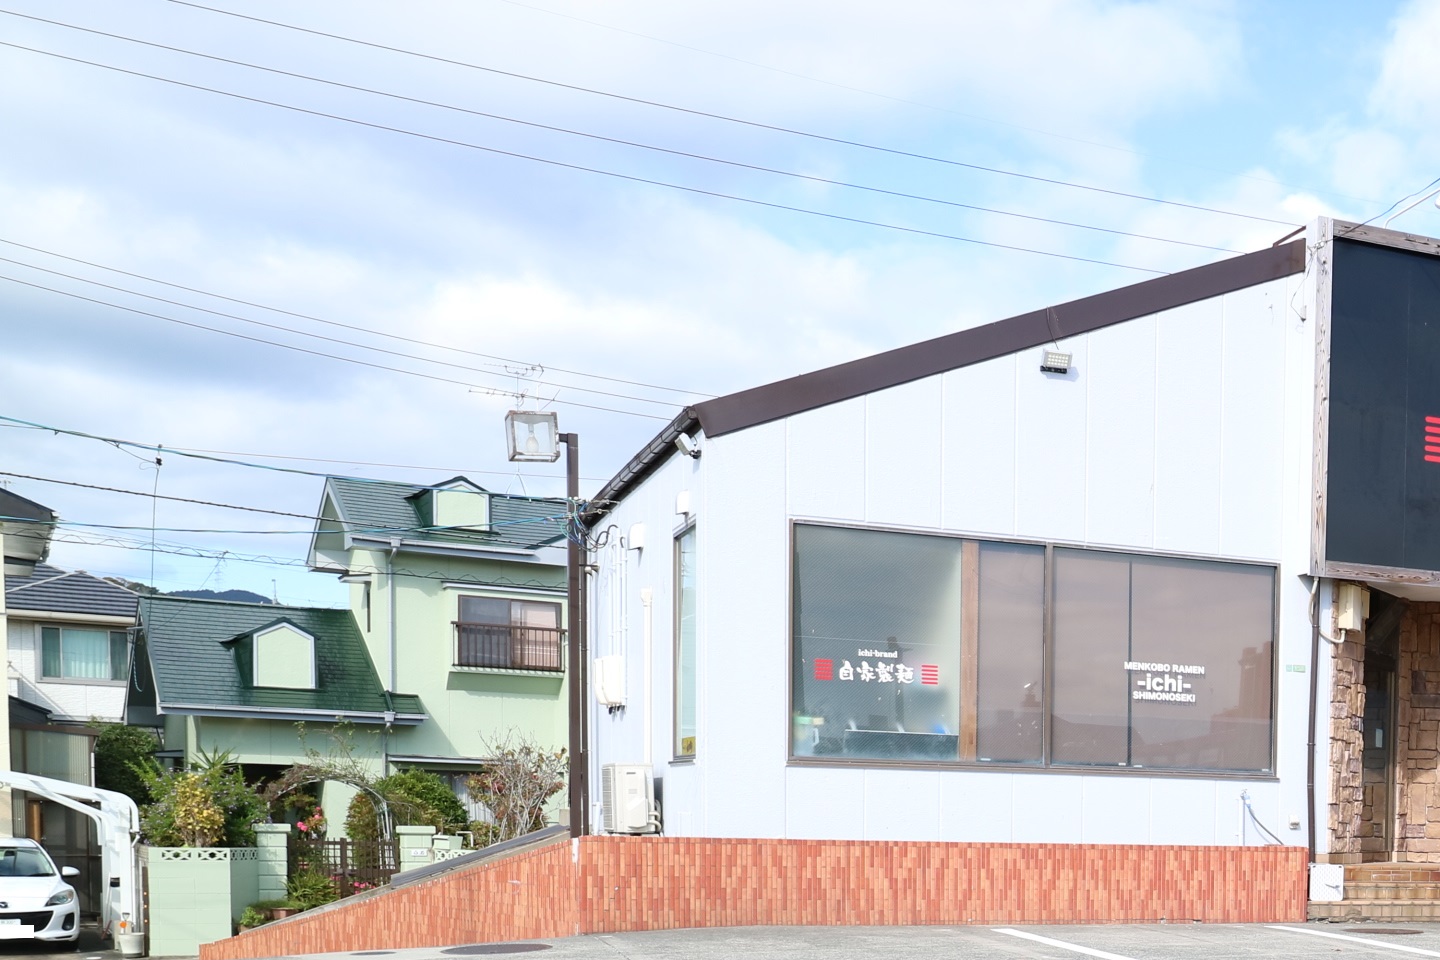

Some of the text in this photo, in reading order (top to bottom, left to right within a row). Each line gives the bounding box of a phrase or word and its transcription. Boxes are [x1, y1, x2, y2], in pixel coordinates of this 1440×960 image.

[858, 648, 898, 658] ichi-brand
[839, 660, 914, 683] 自家製麺
[1124, 661, 1205, 674] MENKOBO RAMEN
[1132, 690, 1196, 703] SHIMONOSEKI
